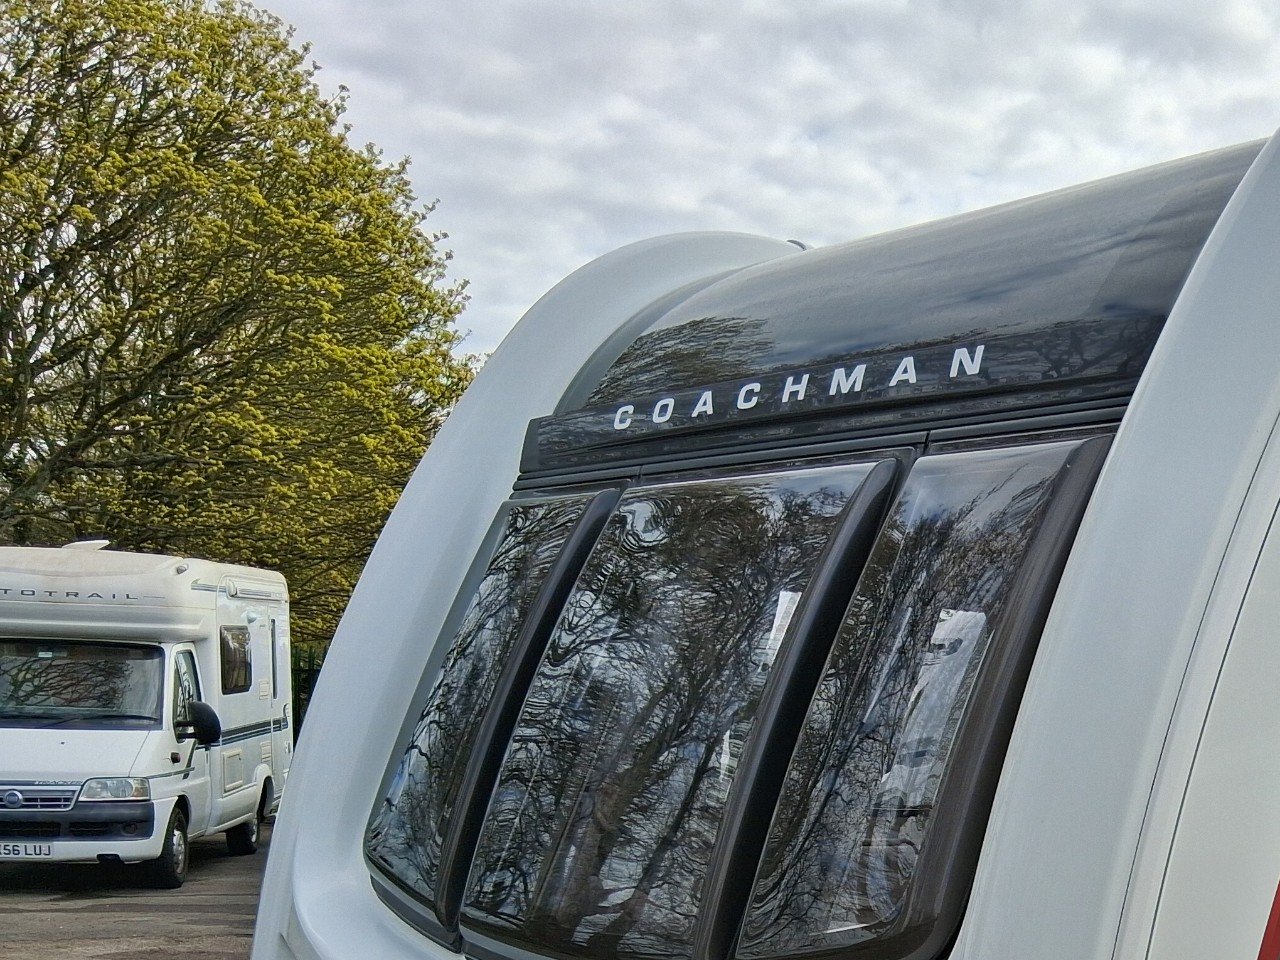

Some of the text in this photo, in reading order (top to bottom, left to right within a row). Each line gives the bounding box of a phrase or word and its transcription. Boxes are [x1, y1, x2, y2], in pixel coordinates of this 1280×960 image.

[613, 345, 985, 431] COACHMAN
[0, 844, 51, 856] 56 LUJ
